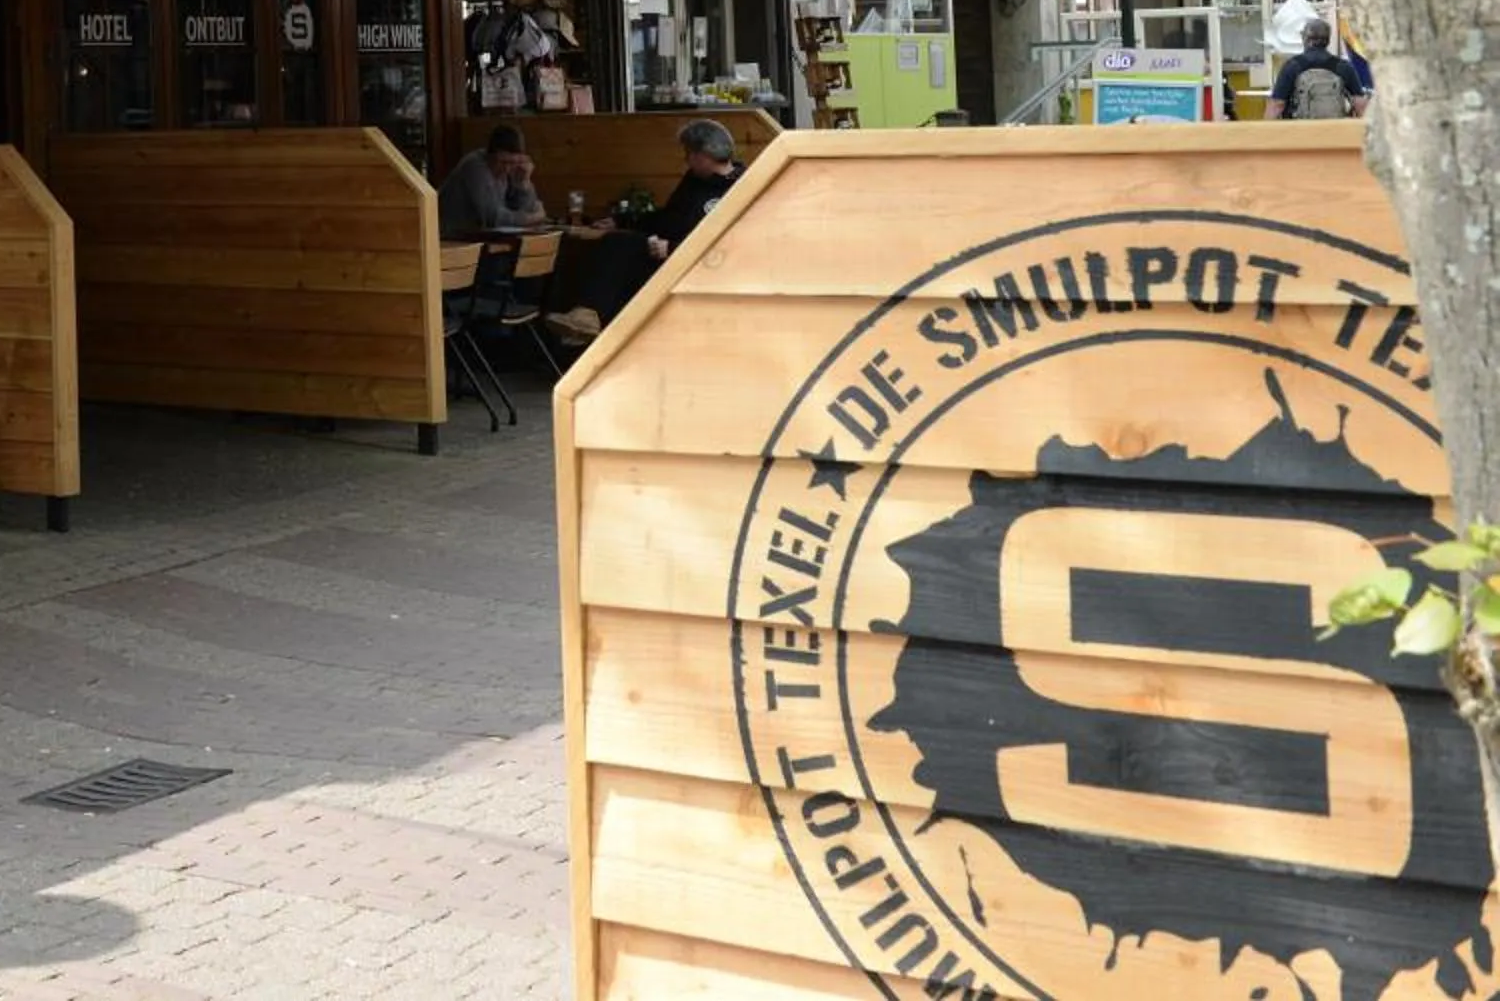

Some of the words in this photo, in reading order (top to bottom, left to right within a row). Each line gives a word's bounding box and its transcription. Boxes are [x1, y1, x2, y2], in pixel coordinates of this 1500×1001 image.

[80, 14, 132, 42] HOTEL
[358, 25, 388, 48] HIGH
[390, 24, 423, 49] WINE
[826, 348, 922, 450] DE
[918, 246, 1300, 369] SMULPOT
[760, 508, 840, 711] TEXEL
[776, 746, 1000, 1001] MULPOT
